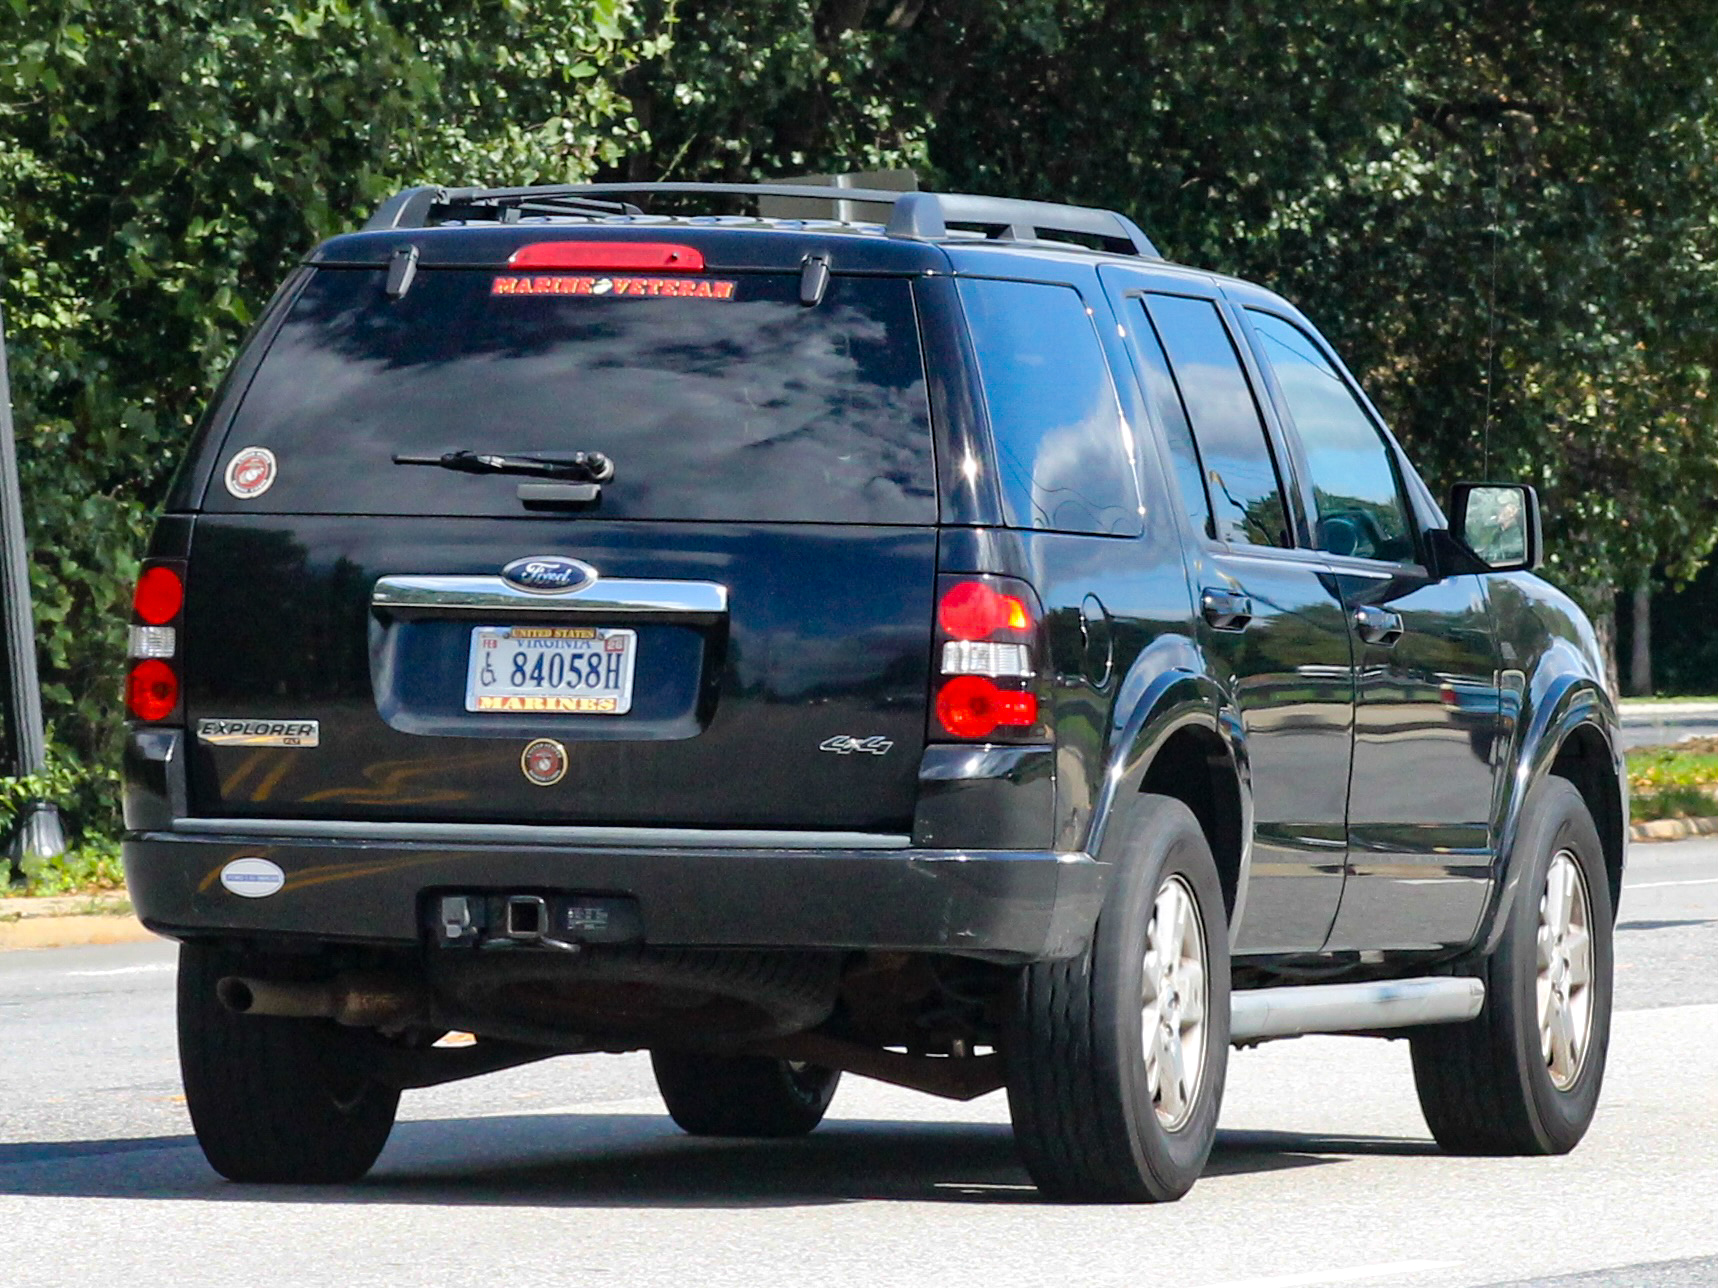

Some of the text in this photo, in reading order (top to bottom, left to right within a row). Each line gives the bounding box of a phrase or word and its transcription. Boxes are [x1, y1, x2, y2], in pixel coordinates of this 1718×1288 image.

[493, 277, 733, 298] MARINE VETERAN
[521, 562, 573, 583] Ford
[512, 628, 595, 639] UNITED STATES
[483, 639, 498, 649] FEB
[516, 639, 592, 649] VIRGINIA
[510, 652, 622, 689] 84058H
[478, 697, 616, 711] MARINES
[201, 722, 314, 736] EXPLORER
